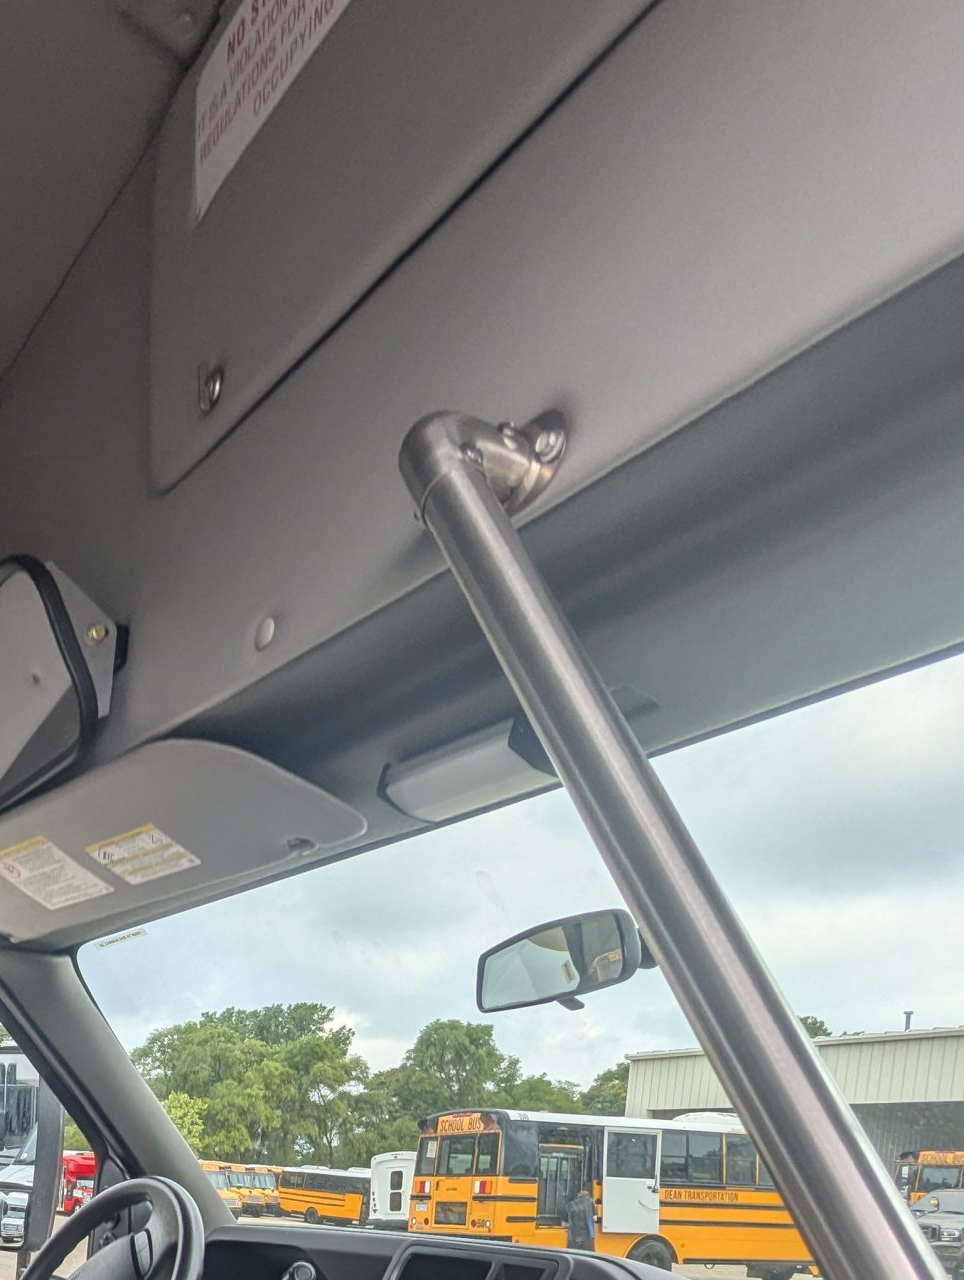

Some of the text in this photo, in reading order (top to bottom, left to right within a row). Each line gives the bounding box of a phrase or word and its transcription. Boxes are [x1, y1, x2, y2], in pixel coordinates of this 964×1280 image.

[227, 17, 245, 62] NO
[199, 36, 276, 168] REGULATIONS
[220, 81, 227, 106] A
[440, 1116, 482, 1132] SCHOOL BUS
[664, 1189, 739, 1202] DEAN TRANSPORTATION
